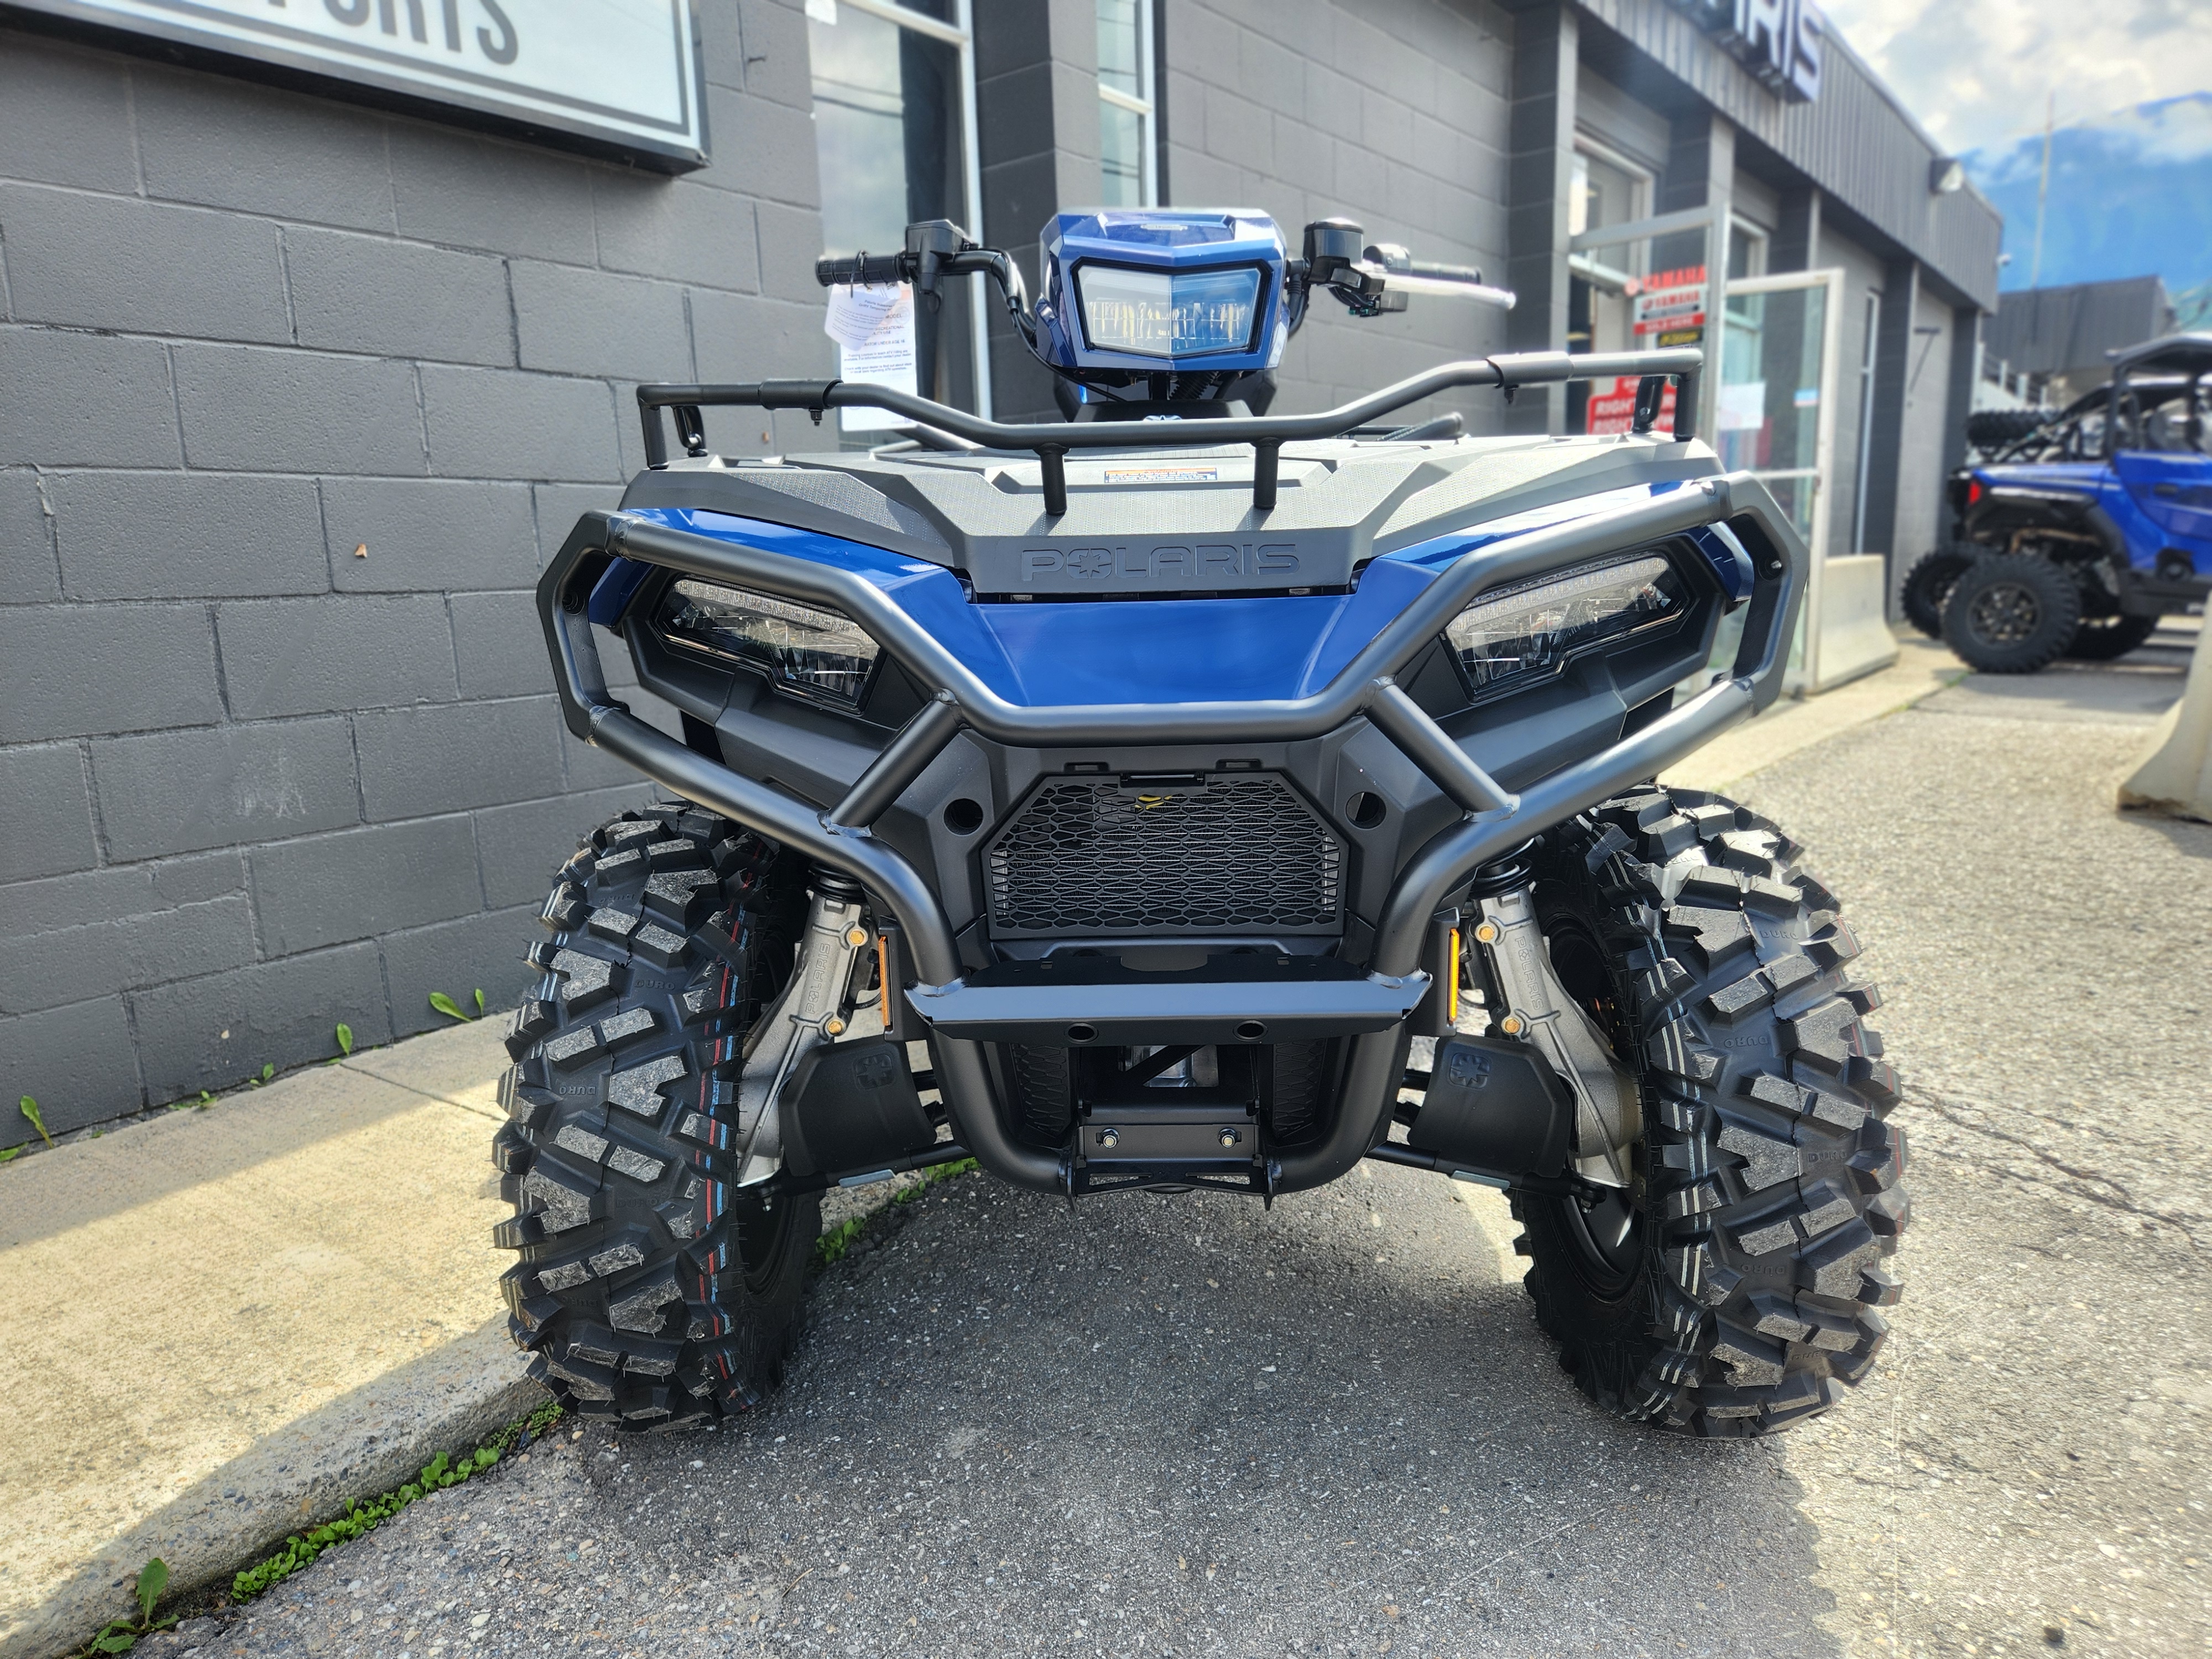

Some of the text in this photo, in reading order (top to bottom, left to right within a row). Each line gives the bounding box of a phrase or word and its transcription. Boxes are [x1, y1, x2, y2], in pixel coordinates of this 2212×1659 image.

[1642, 265, 1705, 294] YAMAHA
[1656, 290, 1699, 307] YAMAHA
[1021, 544, 1300, 582] POLARIS
[598, 893, 635, 905] DURO
[1759, 930, 1799, 940] DURO
[805, 943, 831, 1014] POLARIS
[1515, 936, 1544, 1010] POLARIS
[634, 979, 676, 990] DURO
[1723, 1035, 1768, 1048] DURO
[559, 1086, 597, 1095] DURO
[1808, 1149, 1847, 1163] DURO
[615, 1197, 658, 1208] DURO
[1740, 1264, 1786, 1275] DURO
